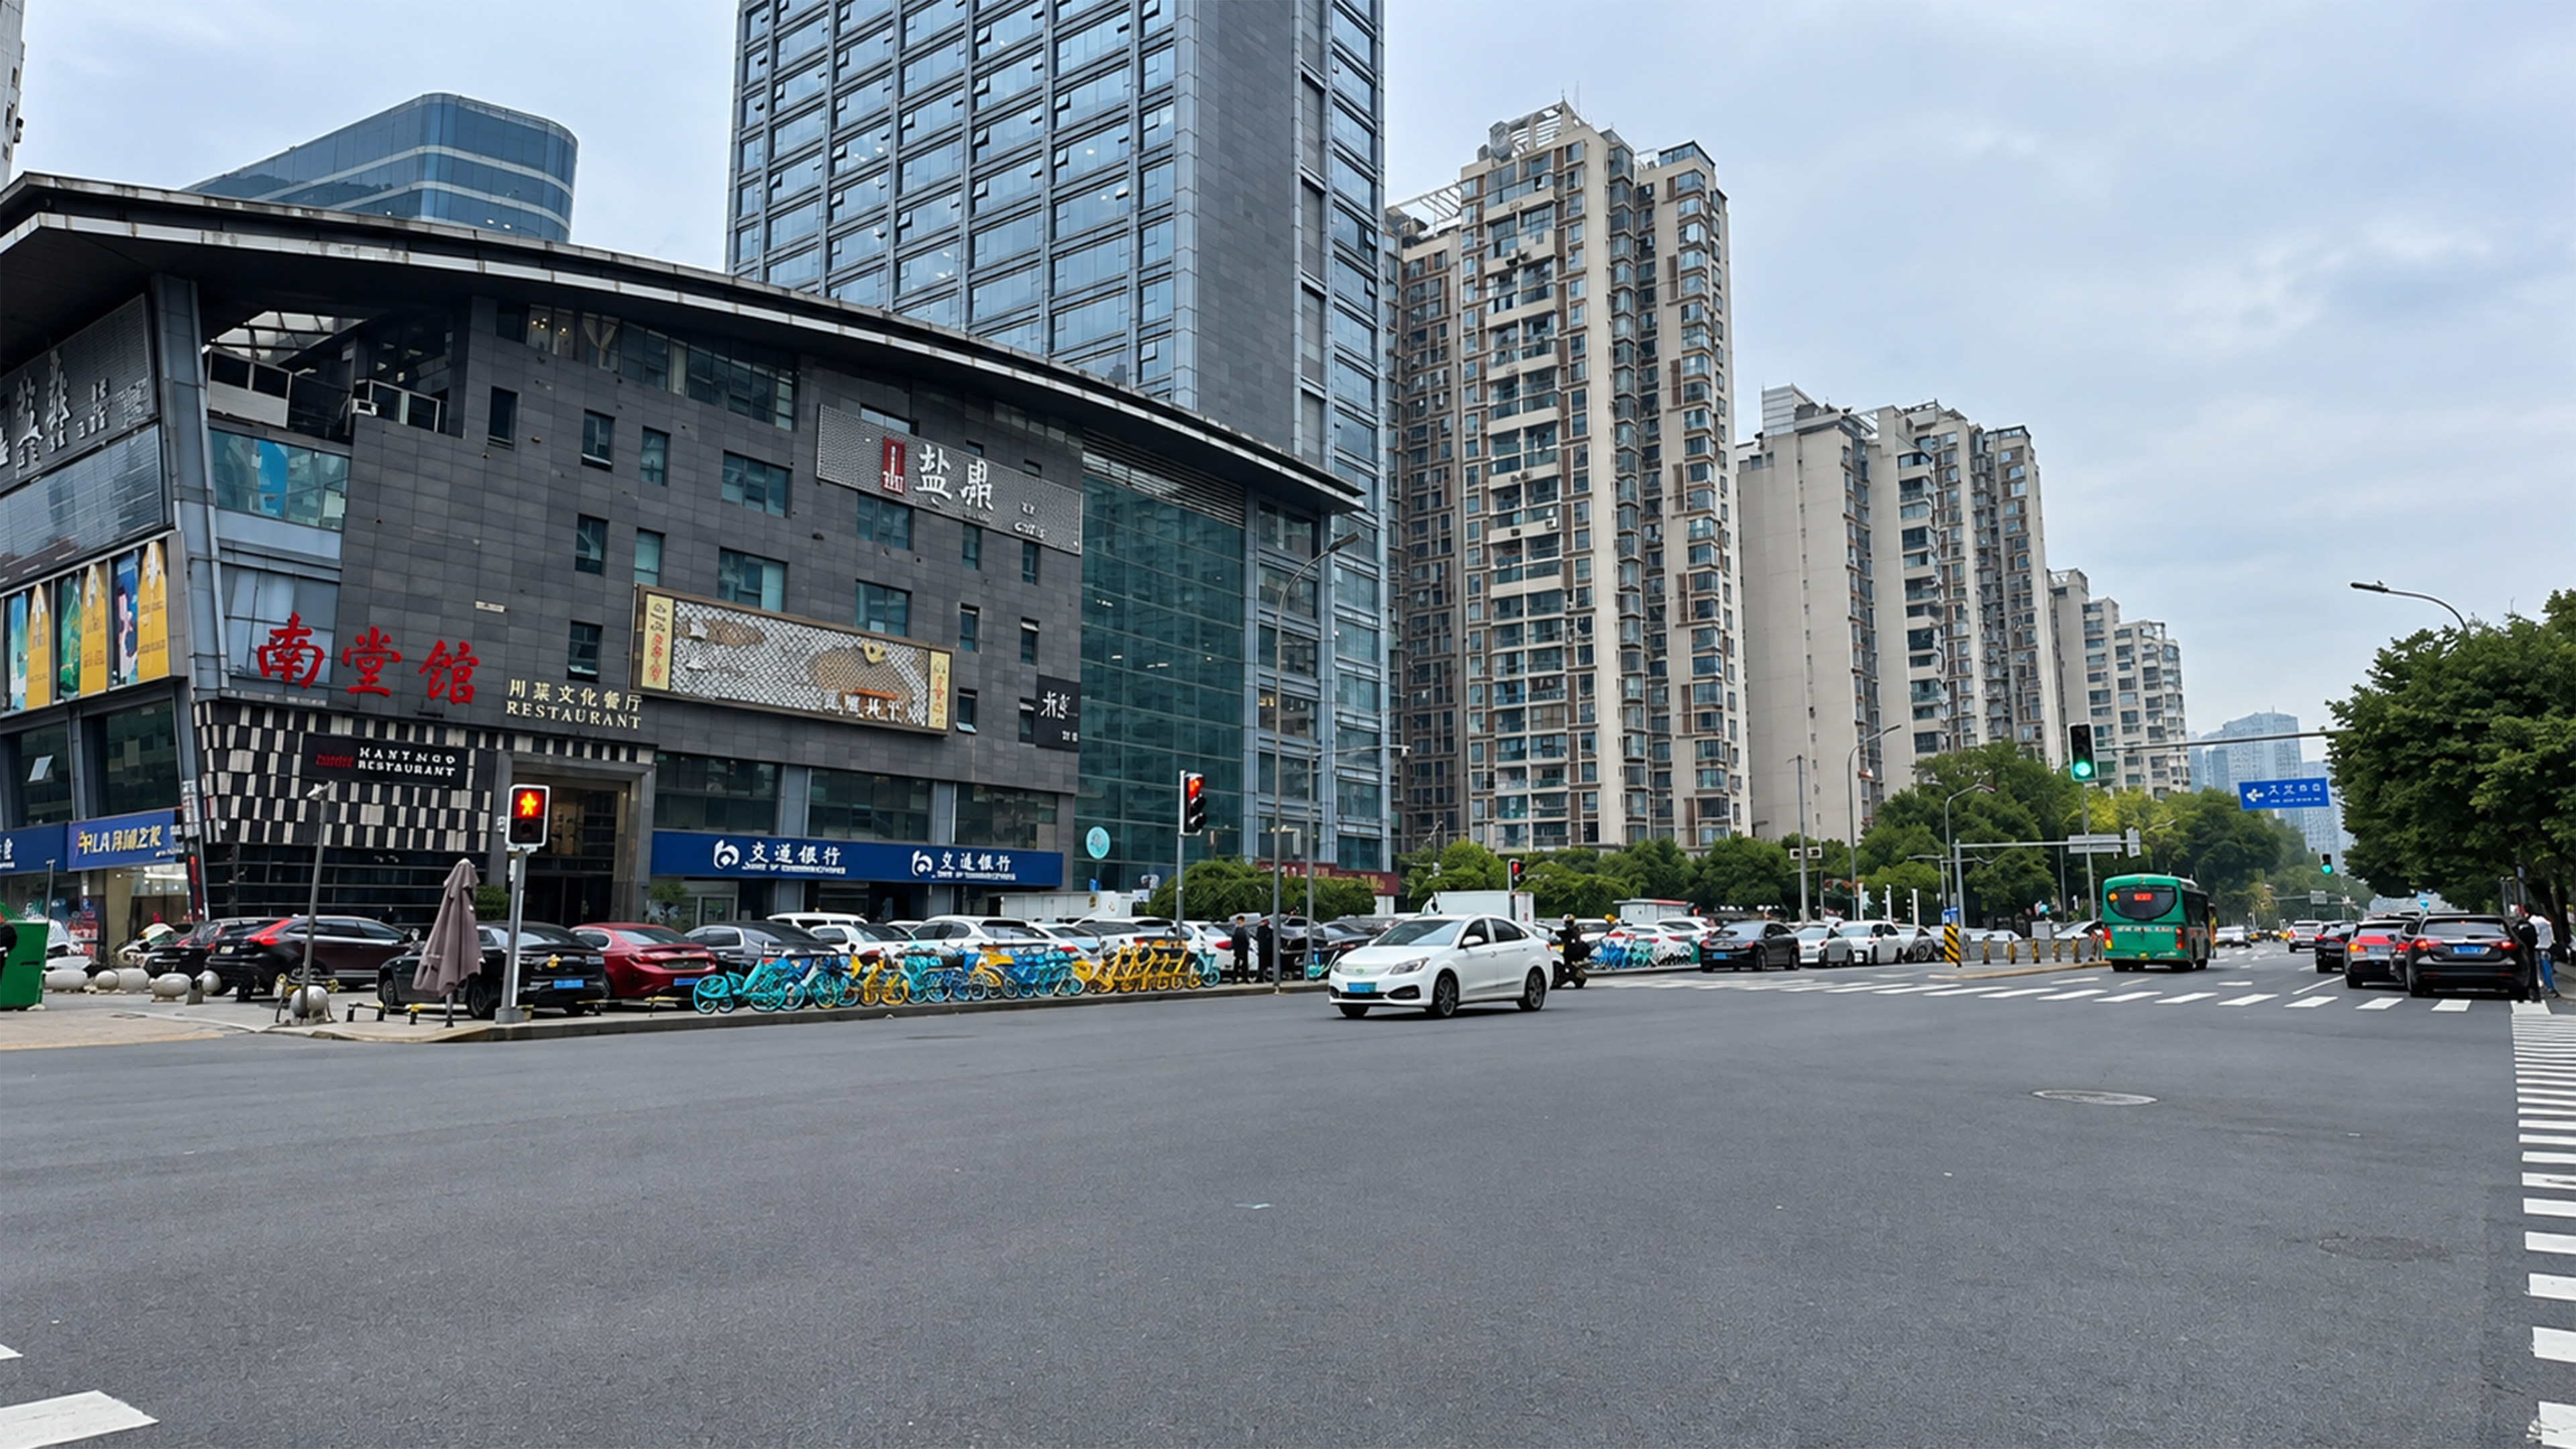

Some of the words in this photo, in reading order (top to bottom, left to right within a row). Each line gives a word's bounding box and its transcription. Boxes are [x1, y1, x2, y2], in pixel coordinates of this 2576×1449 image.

[257, 611, 480, 704] 南堂馆
[508, 679, 642, 712] 川菜文化餐厅
[506, 700, 641, 729] RESTAURANT
